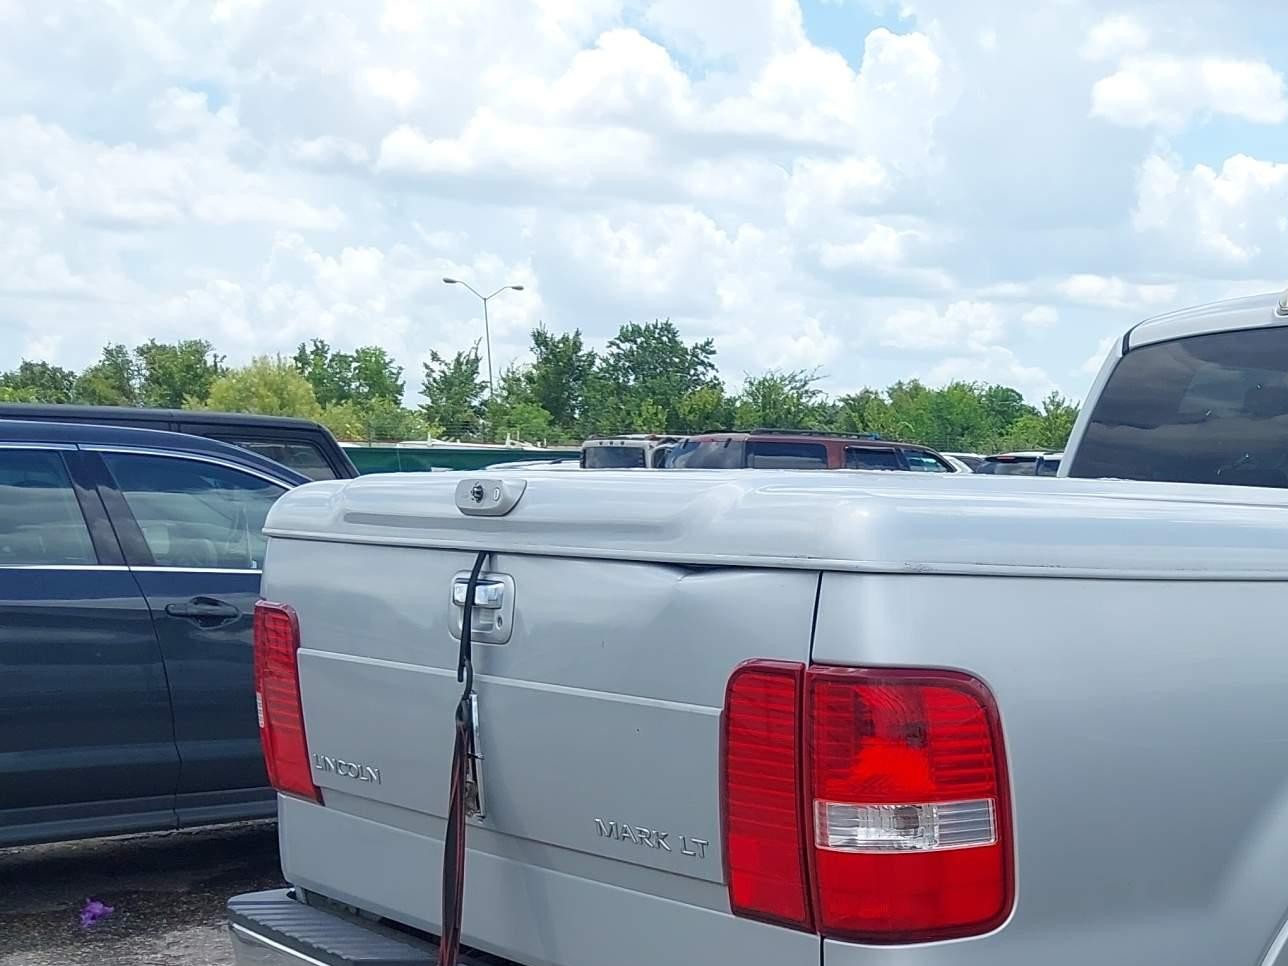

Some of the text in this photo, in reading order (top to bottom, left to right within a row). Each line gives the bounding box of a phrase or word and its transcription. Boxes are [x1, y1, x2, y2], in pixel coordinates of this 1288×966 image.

[312, 753, 382, 785] LINCOLN
[594, 818, 709, 858] MARK LT
